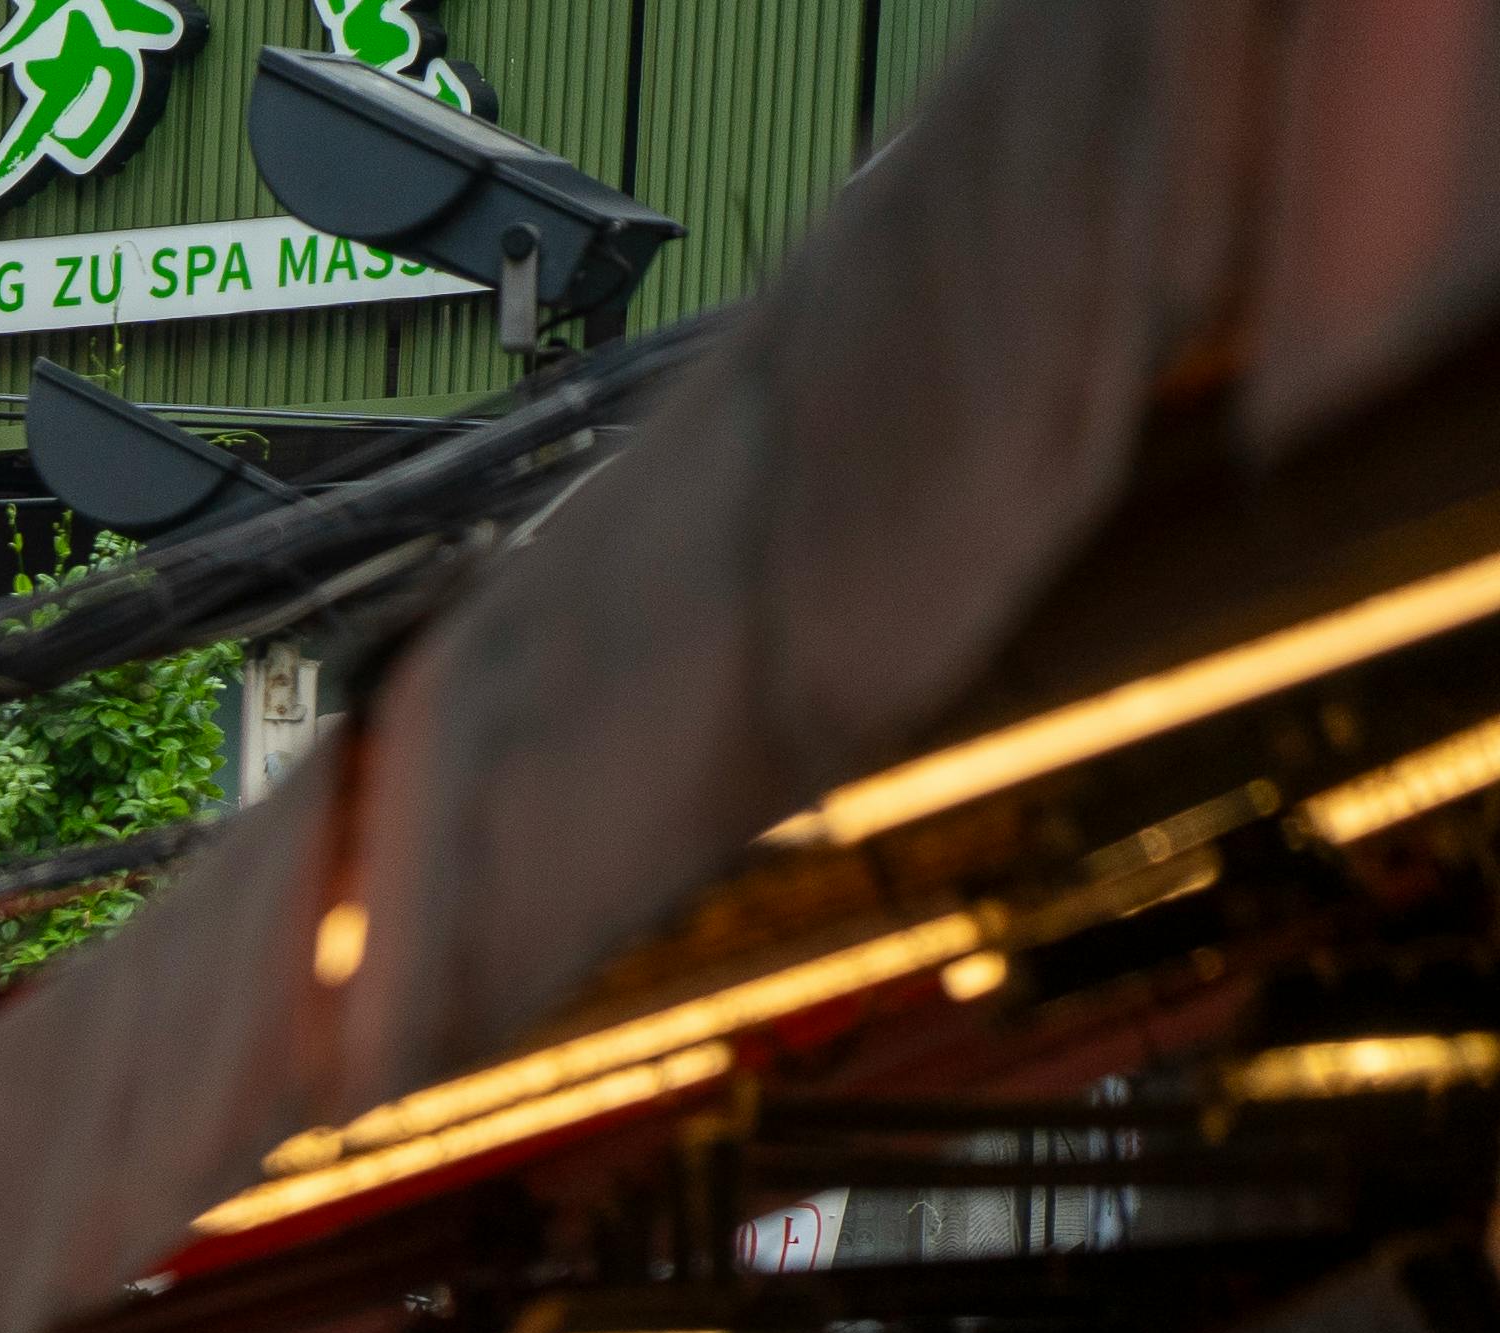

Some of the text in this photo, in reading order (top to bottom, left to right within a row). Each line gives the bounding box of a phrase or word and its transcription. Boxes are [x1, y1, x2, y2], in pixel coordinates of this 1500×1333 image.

[53, 245, 124, 308] ZU
[149, 240, 253, 299] SPA
[278, 234, 445, 287] MAS
